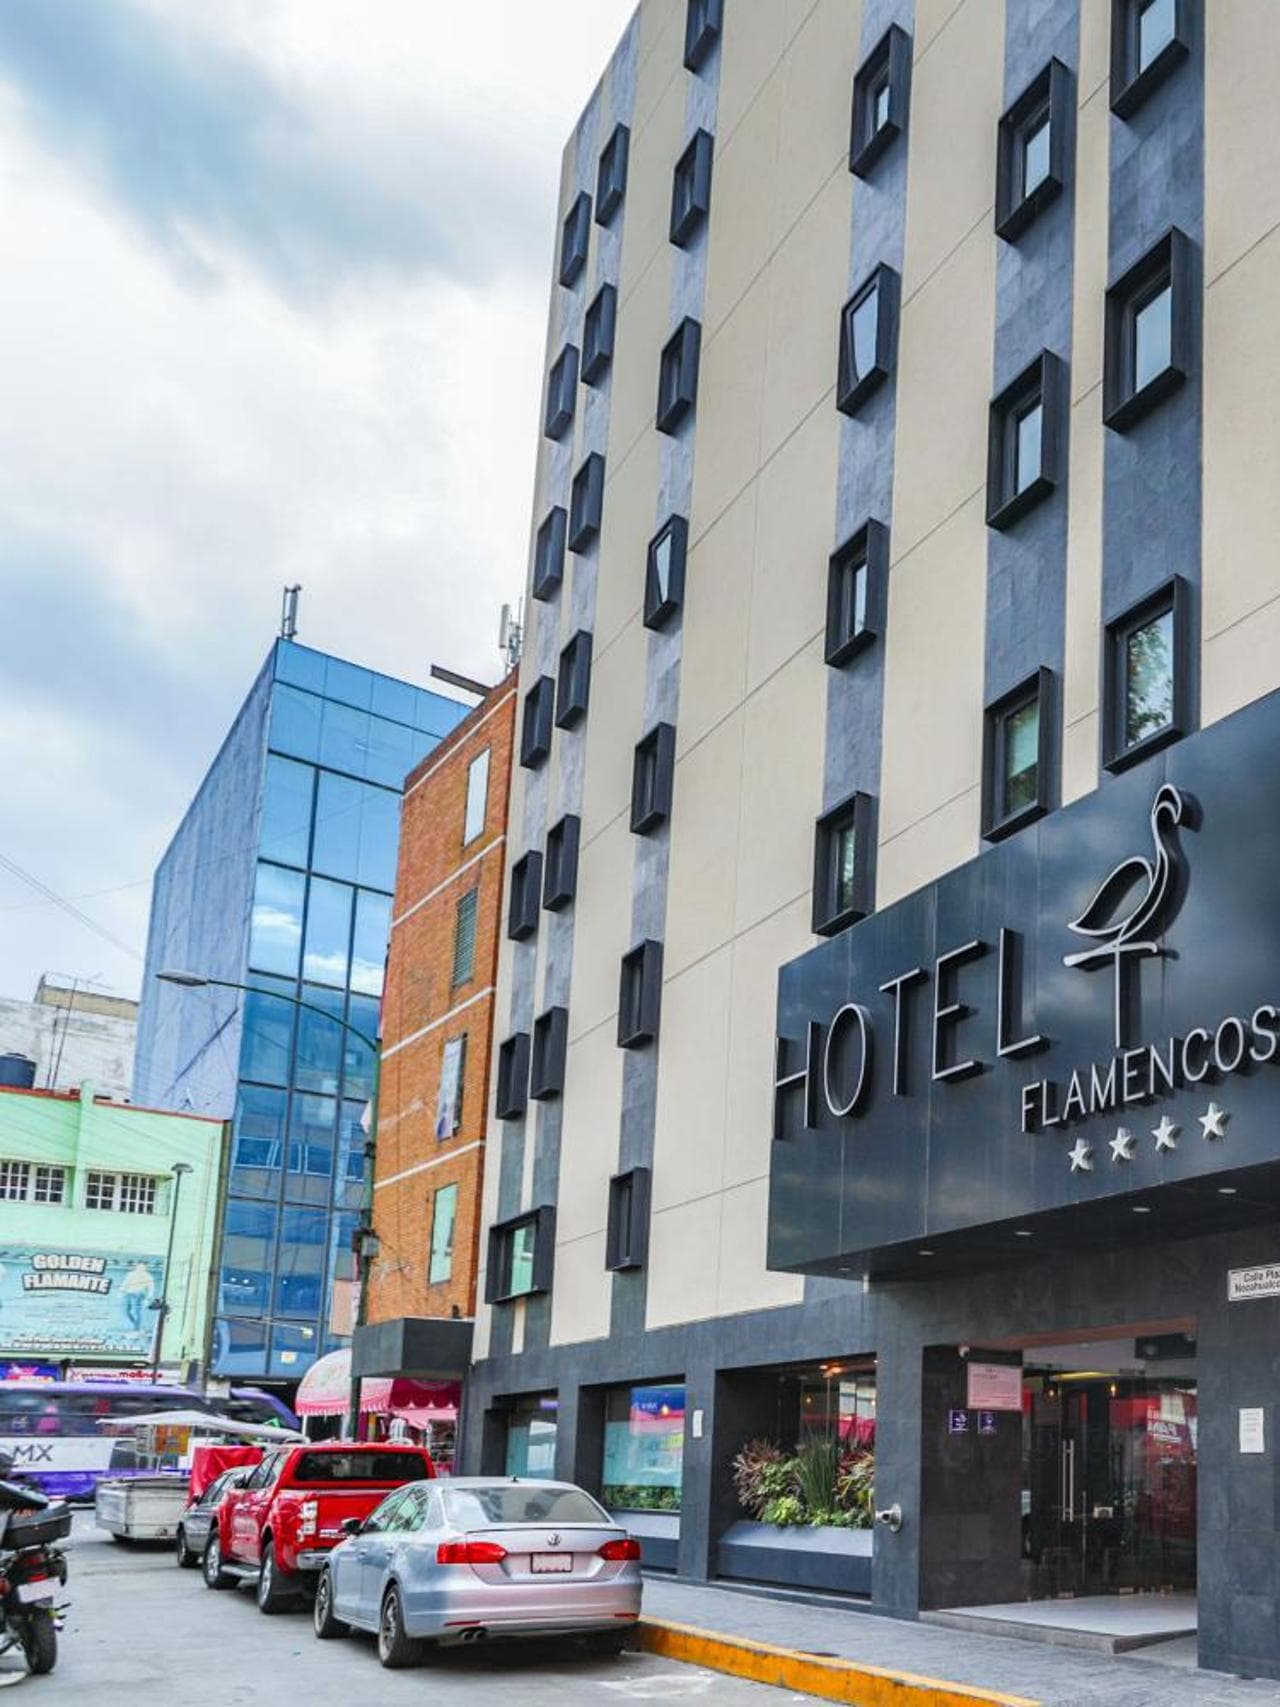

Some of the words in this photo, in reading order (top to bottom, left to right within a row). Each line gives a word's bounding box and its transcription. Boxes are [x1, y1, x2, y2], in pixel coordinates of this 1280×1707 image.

[774, 927, 1048, 1140] HOTEL
[33, 1253, 106, 1274] GOLDEN
[23, 1273, 111, 1294] FLAMANTE
